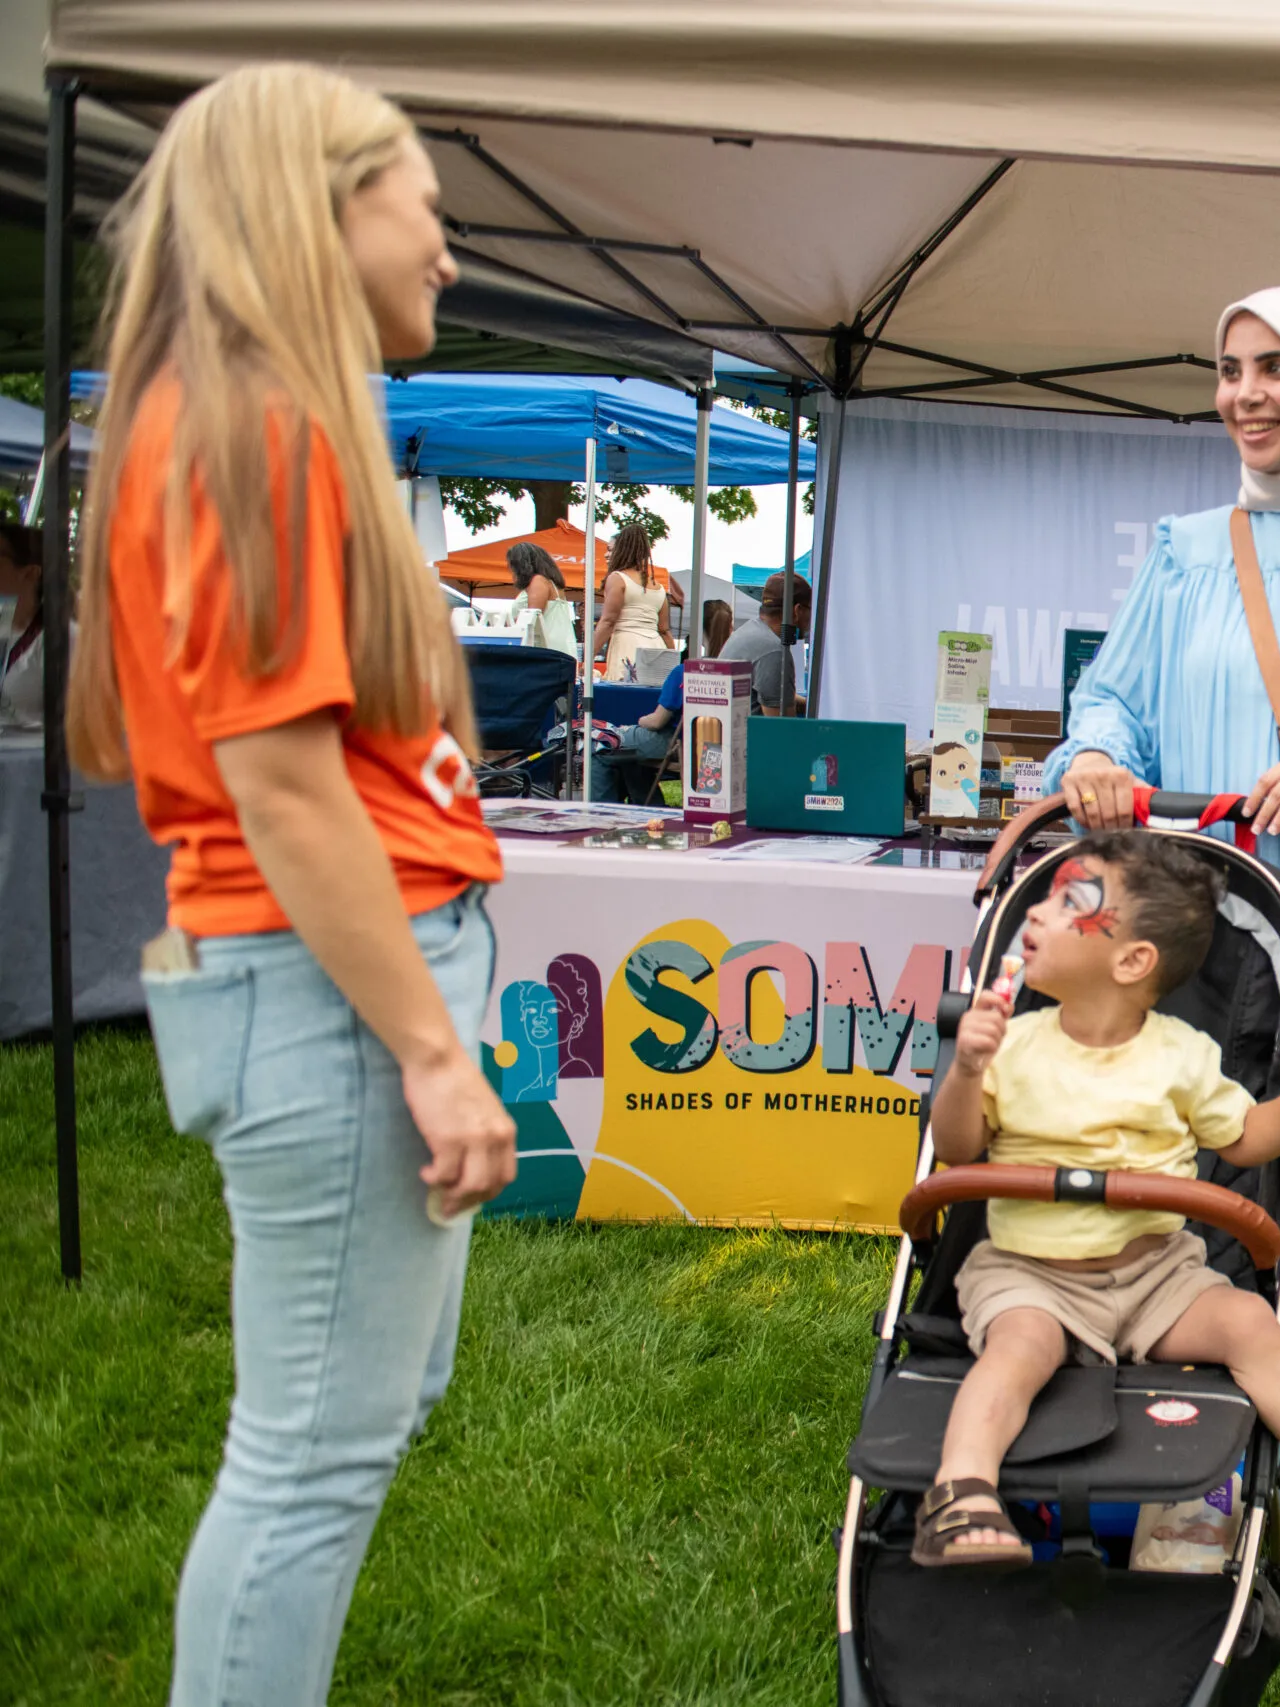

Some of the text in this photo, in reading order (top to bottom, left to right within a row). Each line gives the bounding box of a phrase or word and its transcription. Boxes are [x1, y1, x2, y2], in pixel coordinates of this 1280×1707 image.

[687, 685, 727, 696] CHILLER
[625, 1092, 921, 1117] SHADES OF MOTHERHOOD
